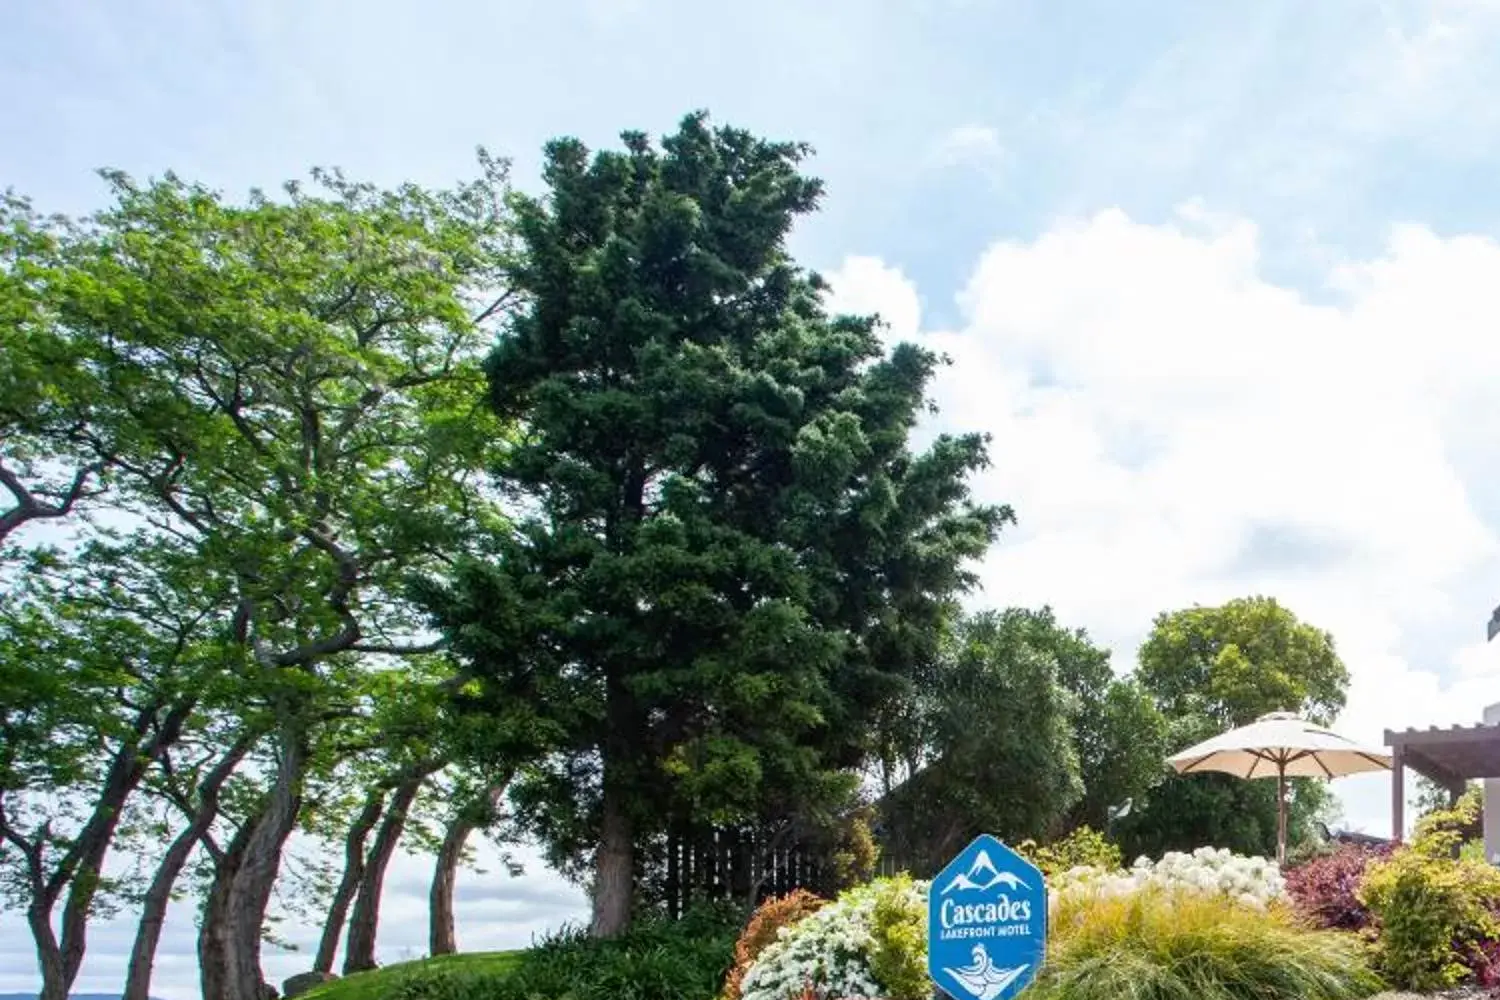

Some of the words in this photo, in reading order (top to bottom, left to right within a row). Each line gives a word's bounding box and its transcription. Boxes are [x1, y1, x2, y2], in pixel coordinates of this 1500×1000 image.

[940, 893, 1031, 929] Cascades
[940, 926, 995, 940] LAKEFRONT
[998, 925, 1031, 936] MOTEL
